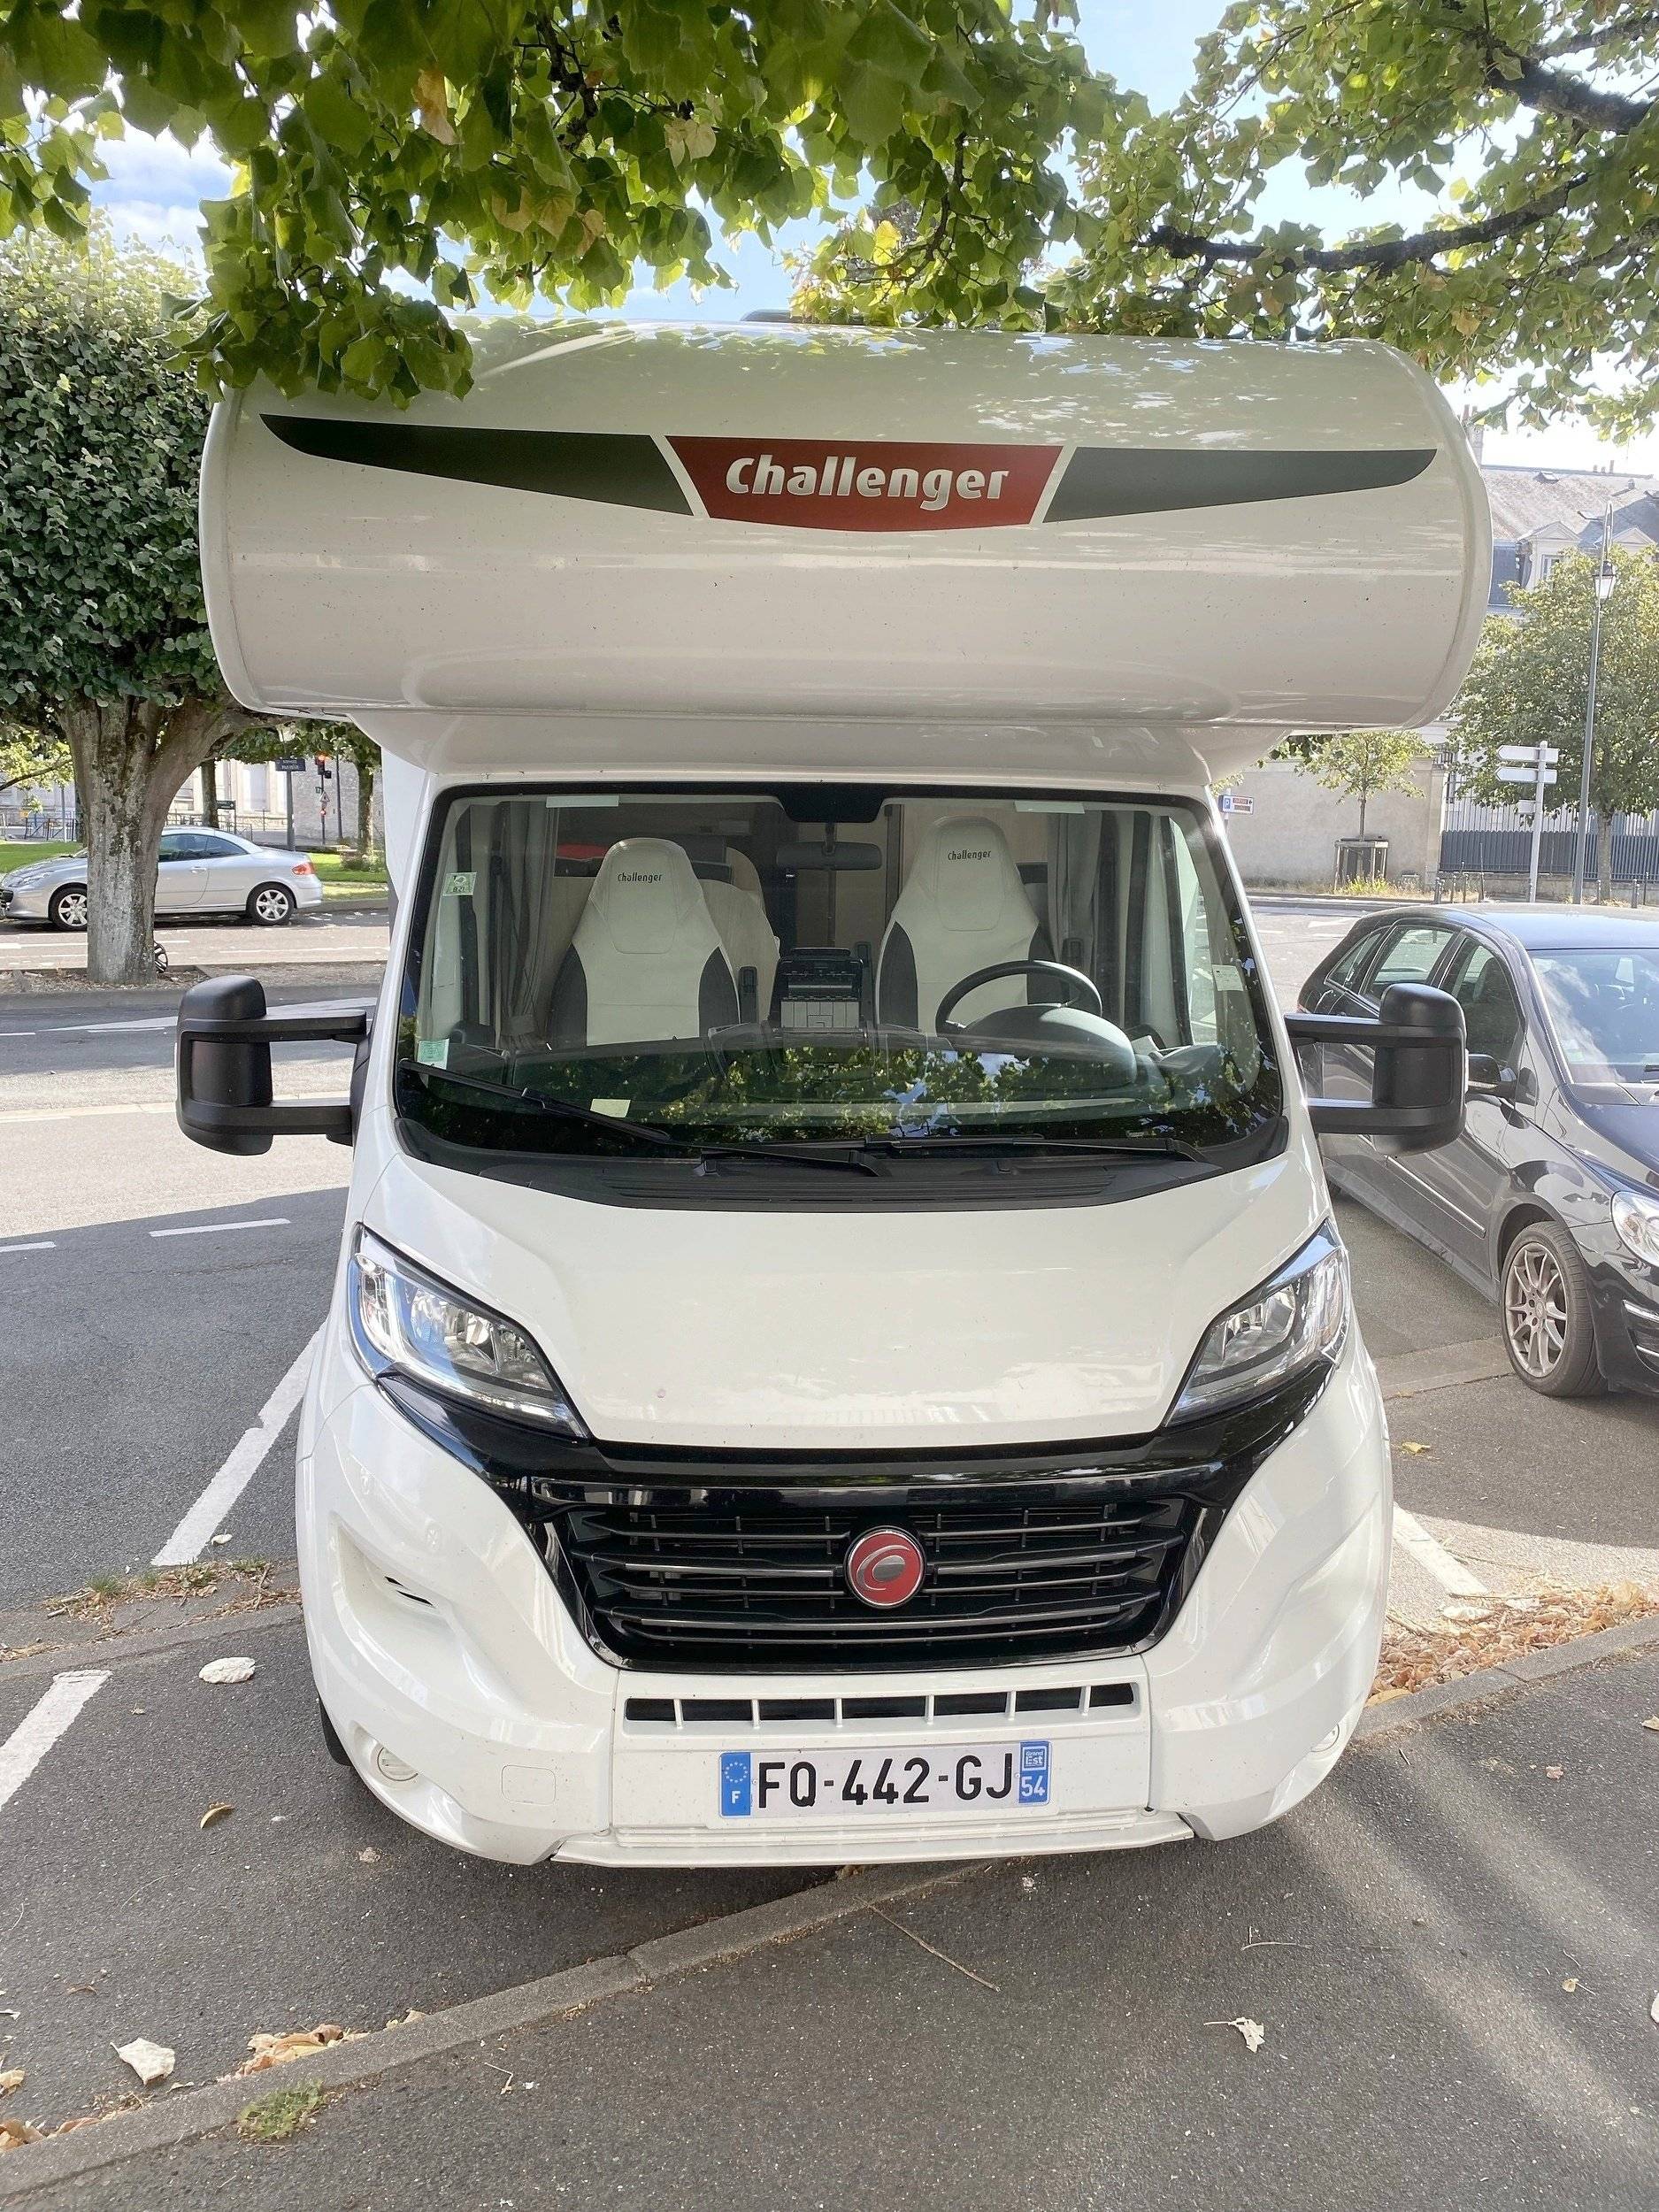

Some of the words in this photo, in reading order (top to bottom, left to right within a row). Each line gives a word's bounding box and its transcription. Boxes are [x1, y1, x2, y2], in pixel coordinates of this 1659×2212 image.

[726, 454, 1010, 511] Challenger
[948, 849, 992, 861] Challenger
[617, 872, 662, 884] Challenger
[1025, 1755, 1044, 1765] Est
[758, 1753, 1014, 1809] FQ-442-GJ
[1021, 1775, 1046, 1797] 54
[731, 1790, 741, 1804] F
